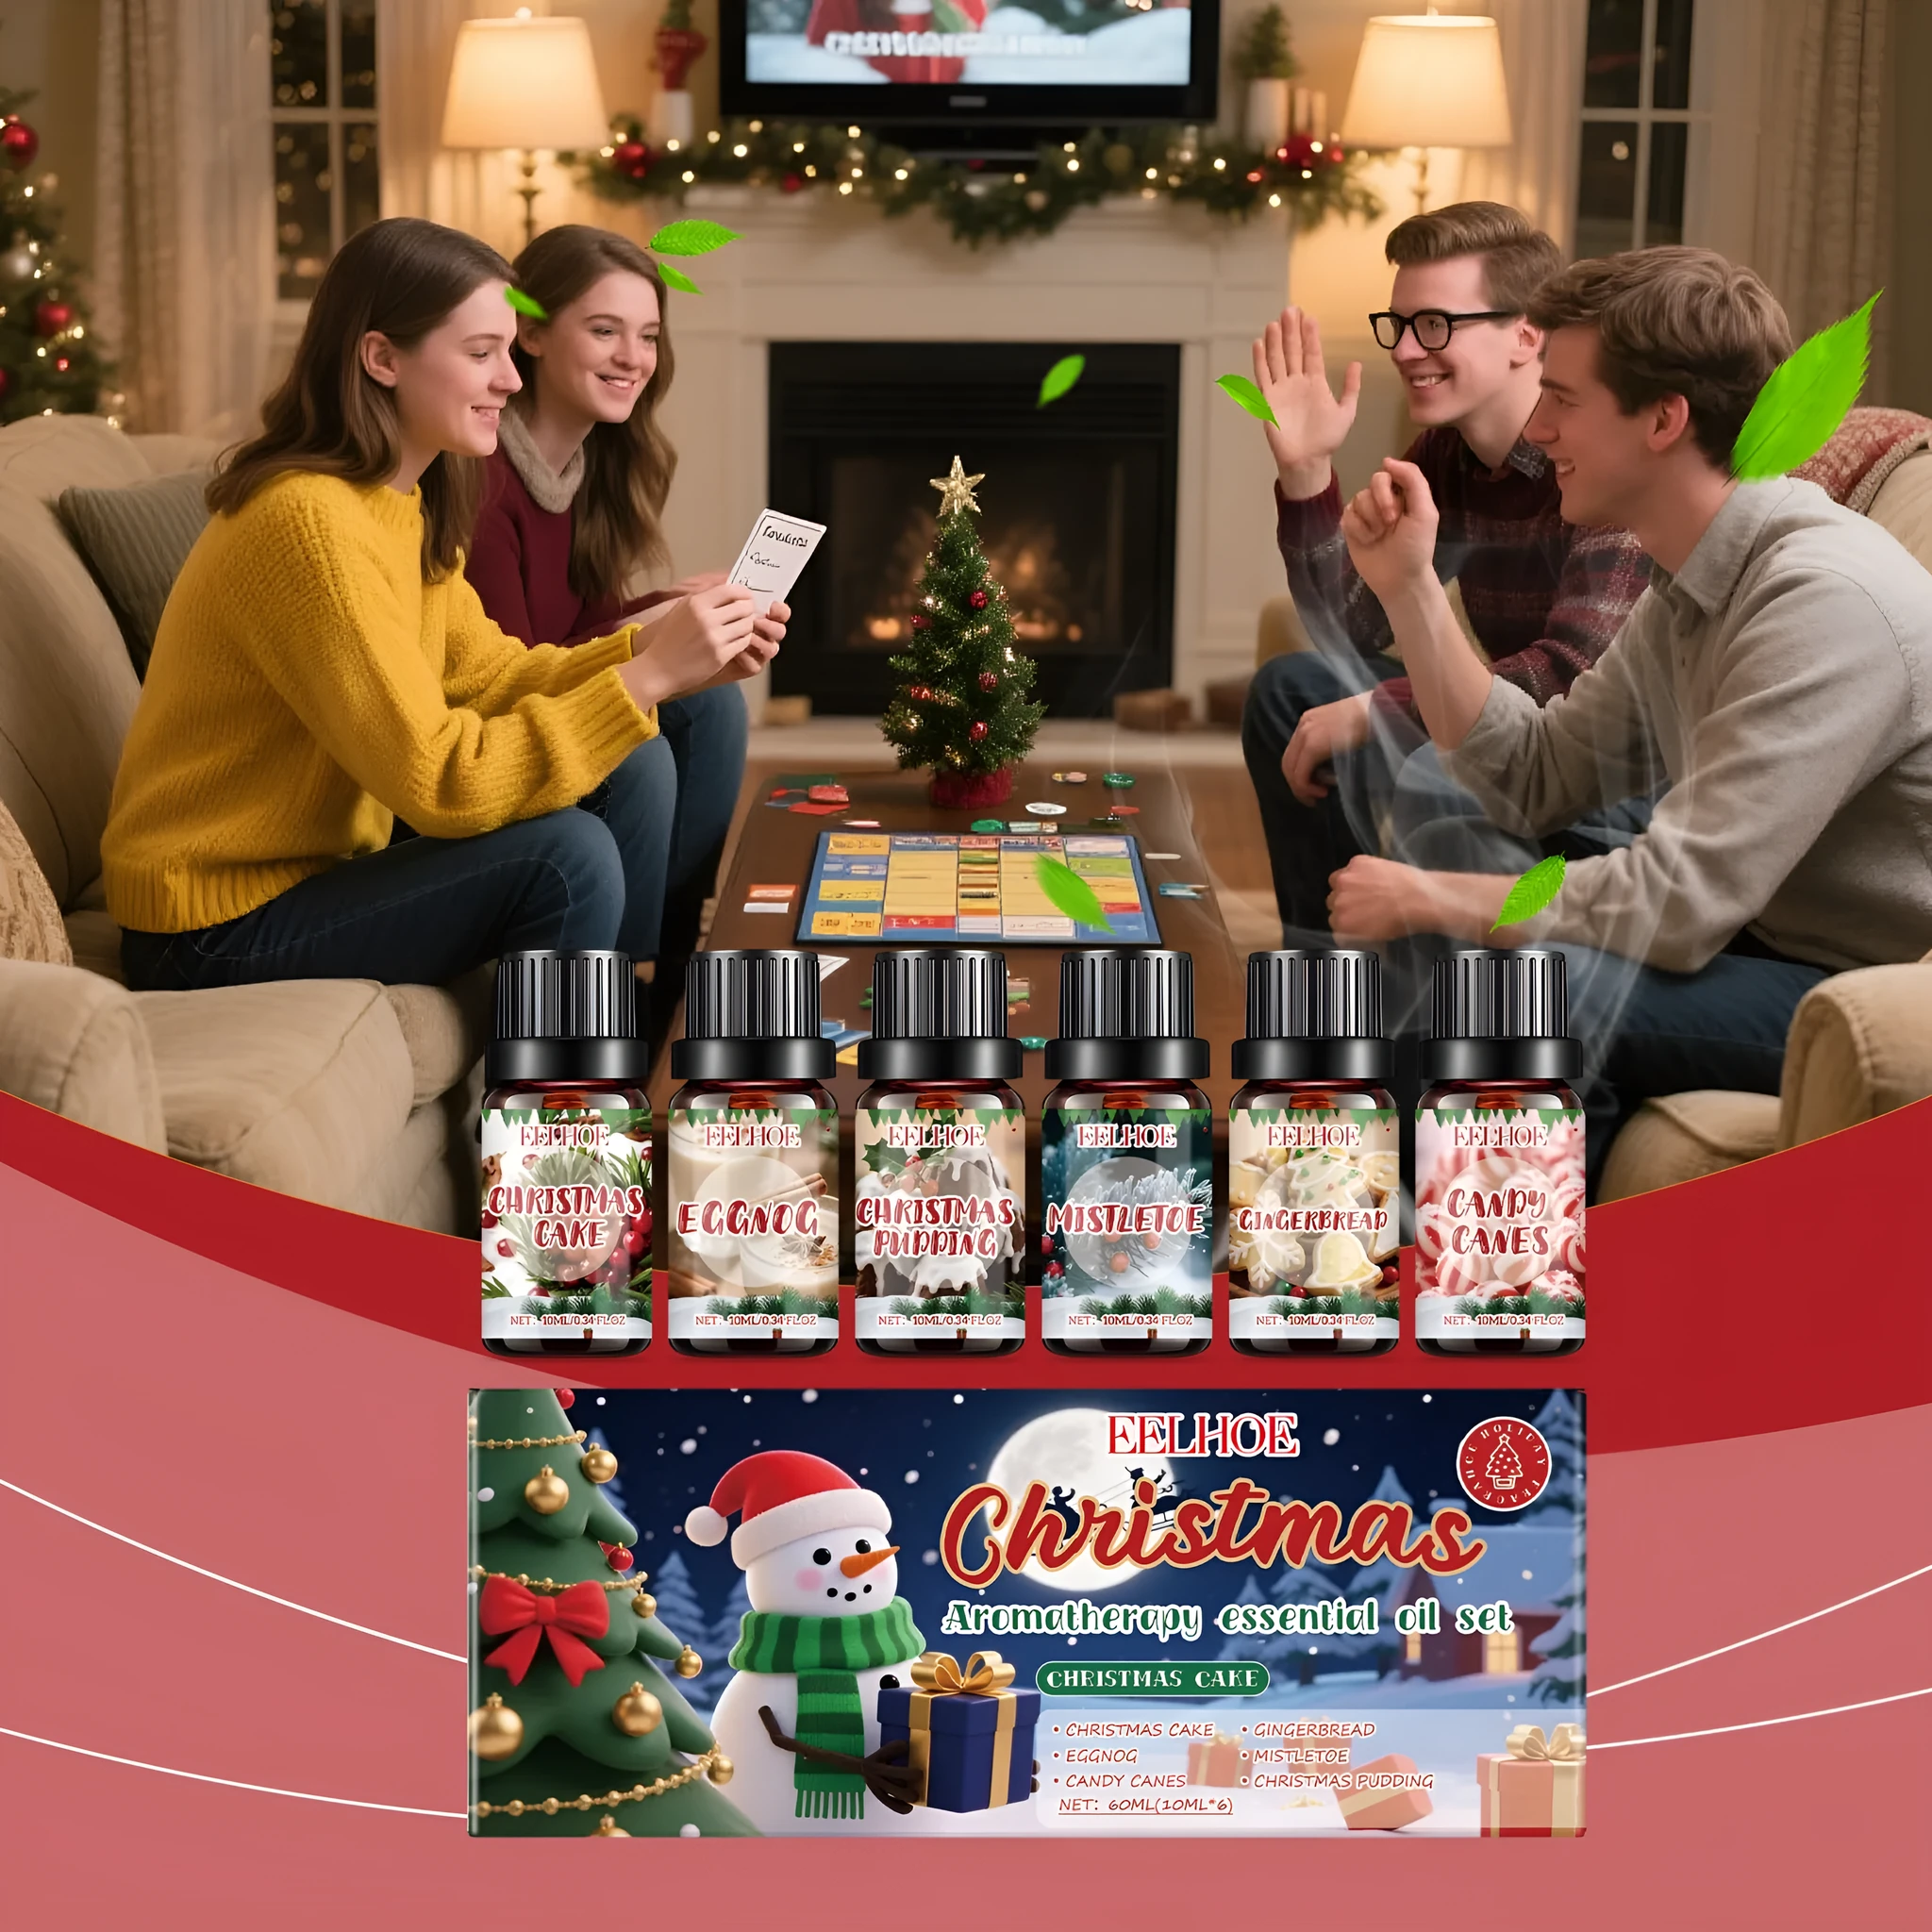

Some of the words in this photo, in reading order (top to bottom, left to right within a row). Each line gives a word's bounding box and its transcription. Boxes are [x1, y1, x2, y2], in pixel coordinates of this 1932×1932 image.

[521, 1124, 609, 1146] EELHOE
[707, 1124, 800, 1146] EELHOE
[888, 1124, 984, 1146] EELHOE
[1077, 1124, 1176, 1146] EELHOE
[1268, 1124, 1360, 1146] EELHOE
[1454, 1124, 1547, 1146] EELHOE
[489, 1185, 644, 1215] CHRISTMAS
[857, 1196, 1014, 1225] CHRISTMAS
[1447, 1188, 1547, 1218] CANDY
[677, 1199, 819, 1235] EGGNOG
[1048, 1204, 1205, 1233] MISTLETOE
[1240, 1208, 1388, 1230] GINGERBREAD
[534, 1219, 606, 1248] CAKE
[874, 1228, 996, 1257] PUDDING
[1452, 1225, 1549, 1256] CANES
[510, 1315, 536, 1325] NET:
[695, 1315, 723, 1325] NET:
[878, 1315, 906, 1325] NET:
[1068, 1315, 1095, 1325] NET:
[1256, 1315, 1282, 1325] NET:
[1443, 1315, 1470, 1325] NET:
[1108, 1414, 1298, 1456] EELHOE
[1480, 1424, 1546, 1465] HOLIDAY
[941, 1479, 1487, 1588] Christmas
[944, 1600, 1200, 1640] Aromatherapy
[1221, 1600, 1377, 1633] essential
[1399, 1600, 1439, 1633] oil
[1458, 1605, 1512, 1632] set
[1045, 1669, 1183, 1690] CHRISTMAS
[1195, 1669, 1259, 1690] CAKE
[1066, 1723, 1163, 1737] CHRISTMAS
[1169, 1723, 1214, 1737] CAKE
[1254, 1723, 1375, 1737] GINGERBREAD
[1066, 1749, 1138, 1763] EGGNOG
[1254, 1749, 1348, 1763] MISTLETOE
[1066, 1774, 1125, 1788] CANDY
[1131, 1774, 1188, 1788] CANES
[1254, 1774, 1351, 1788] CHRISTMAS
[1358, 1774, 1434, 1789] PUDDING
[1059, 1798, 1098, 1811] NET:
